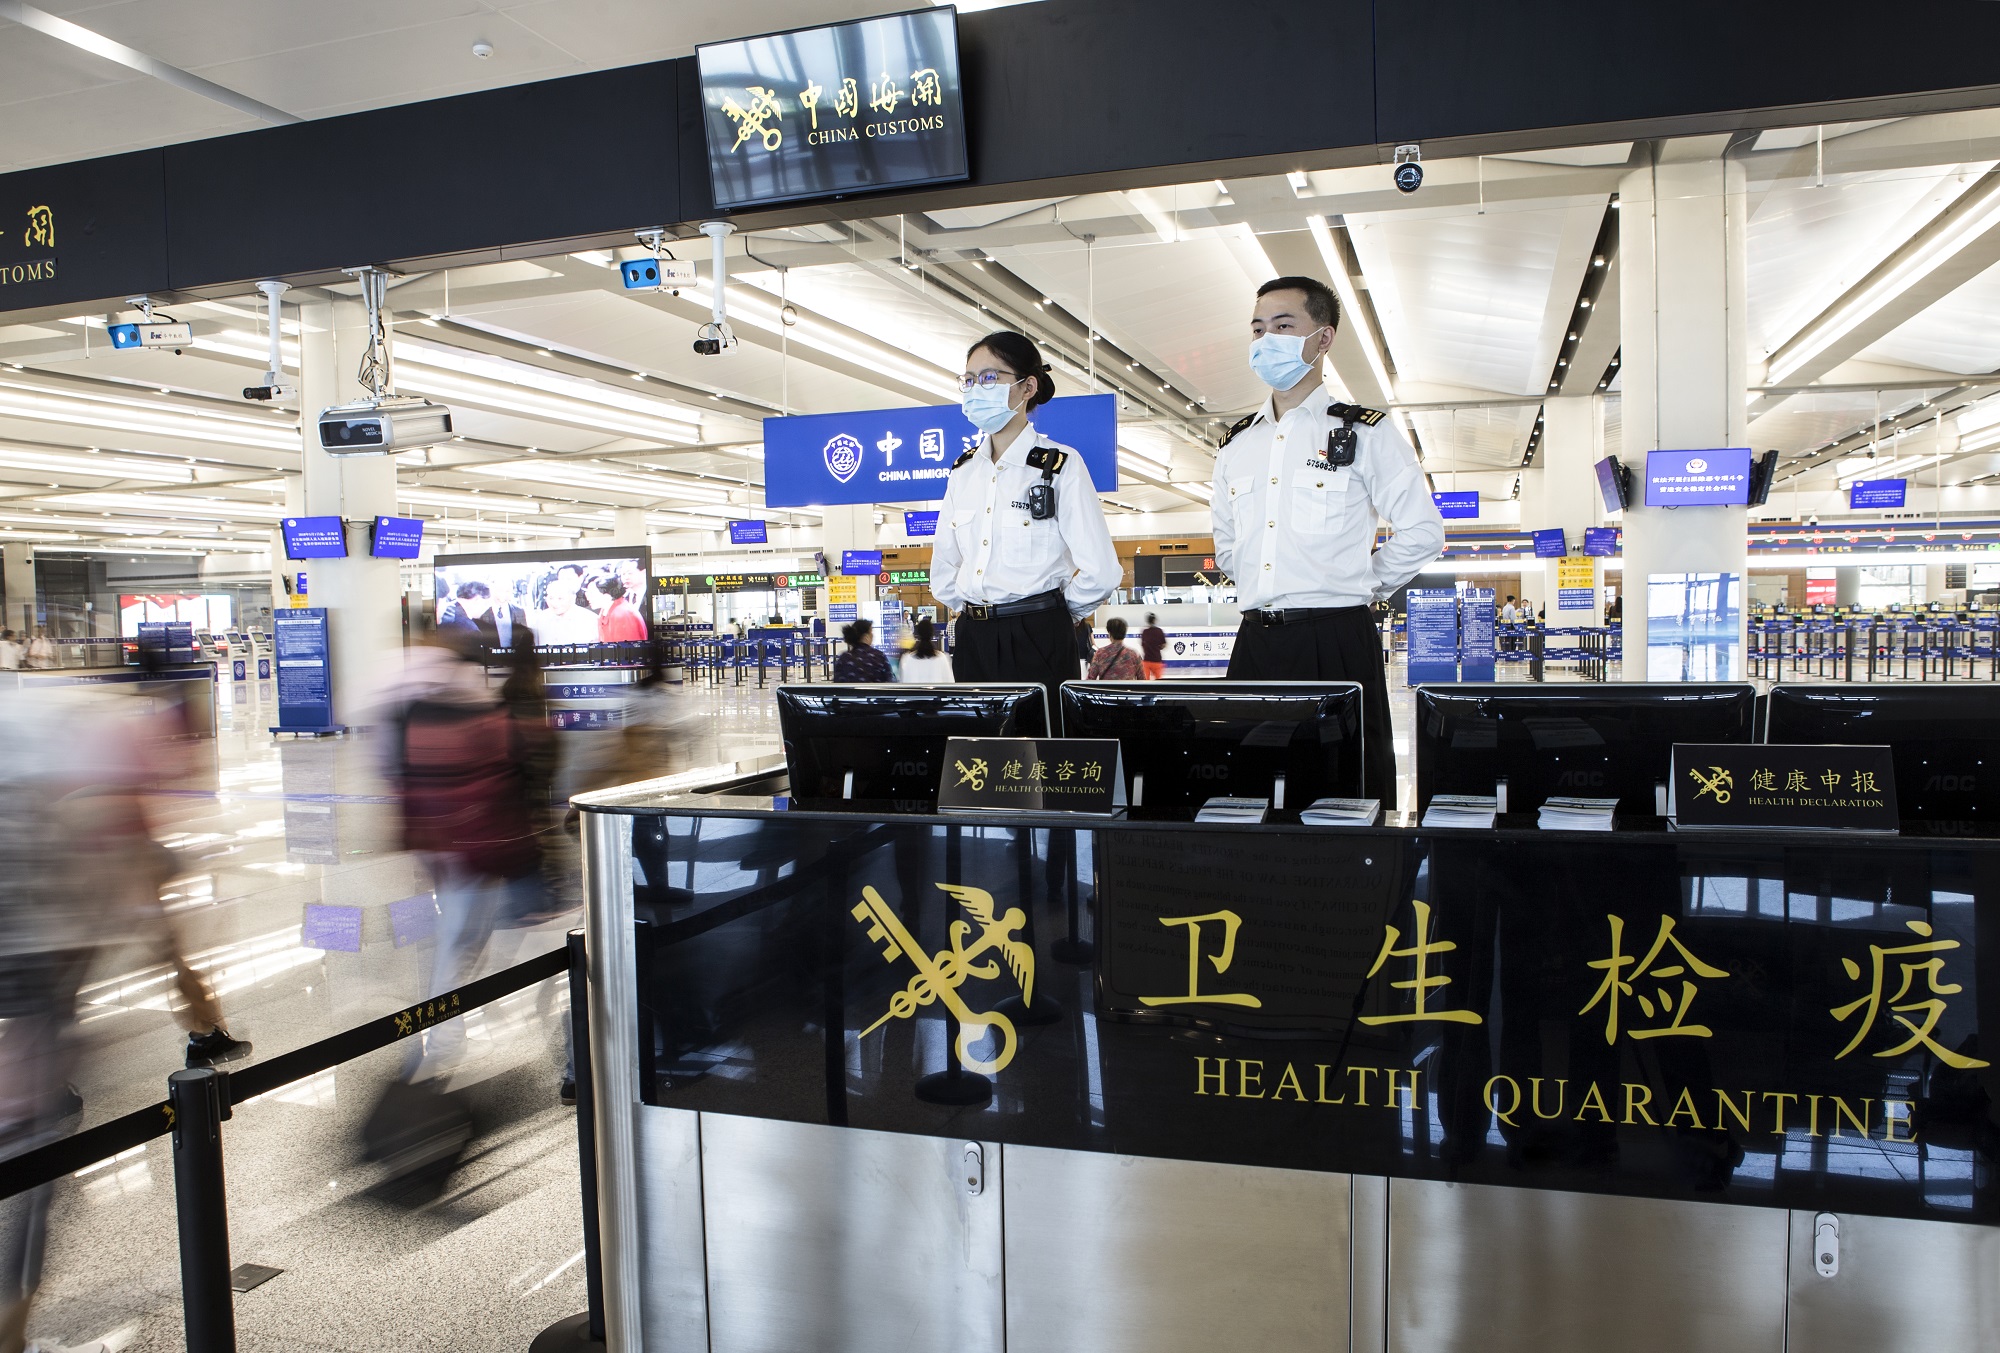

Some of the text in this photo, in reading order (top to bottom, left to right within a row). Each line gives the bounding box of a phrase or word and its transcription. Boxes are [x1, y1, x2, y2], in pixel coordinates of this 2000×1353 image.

[807, 115, 944, 146] CHINA CUSTOMS
[0, 261, 55, 285] TOMS
[878, 469, 911, 482] CHINA
[572, 712, 614, 722] 咨询台
[1000, 759, 1103, 782] 健康咨询
[1556, 770, 1604, 787] AOC
[1749, 767, 1882, 794] 健康申报
[995, 784, 1106, 794] HEALTH CONSULTATION
[1923, 775, 1976, 792] AOC
[1748, 797, 1884, 808] HEALTH DECLARATION
[1138, 899, 1990, 1069] 卫生检疫
[418, 1008, 461, 1030] CHINA CUSTOMS
[1193, 1055, 1919, 1143] HEALTH QUARANTINE
